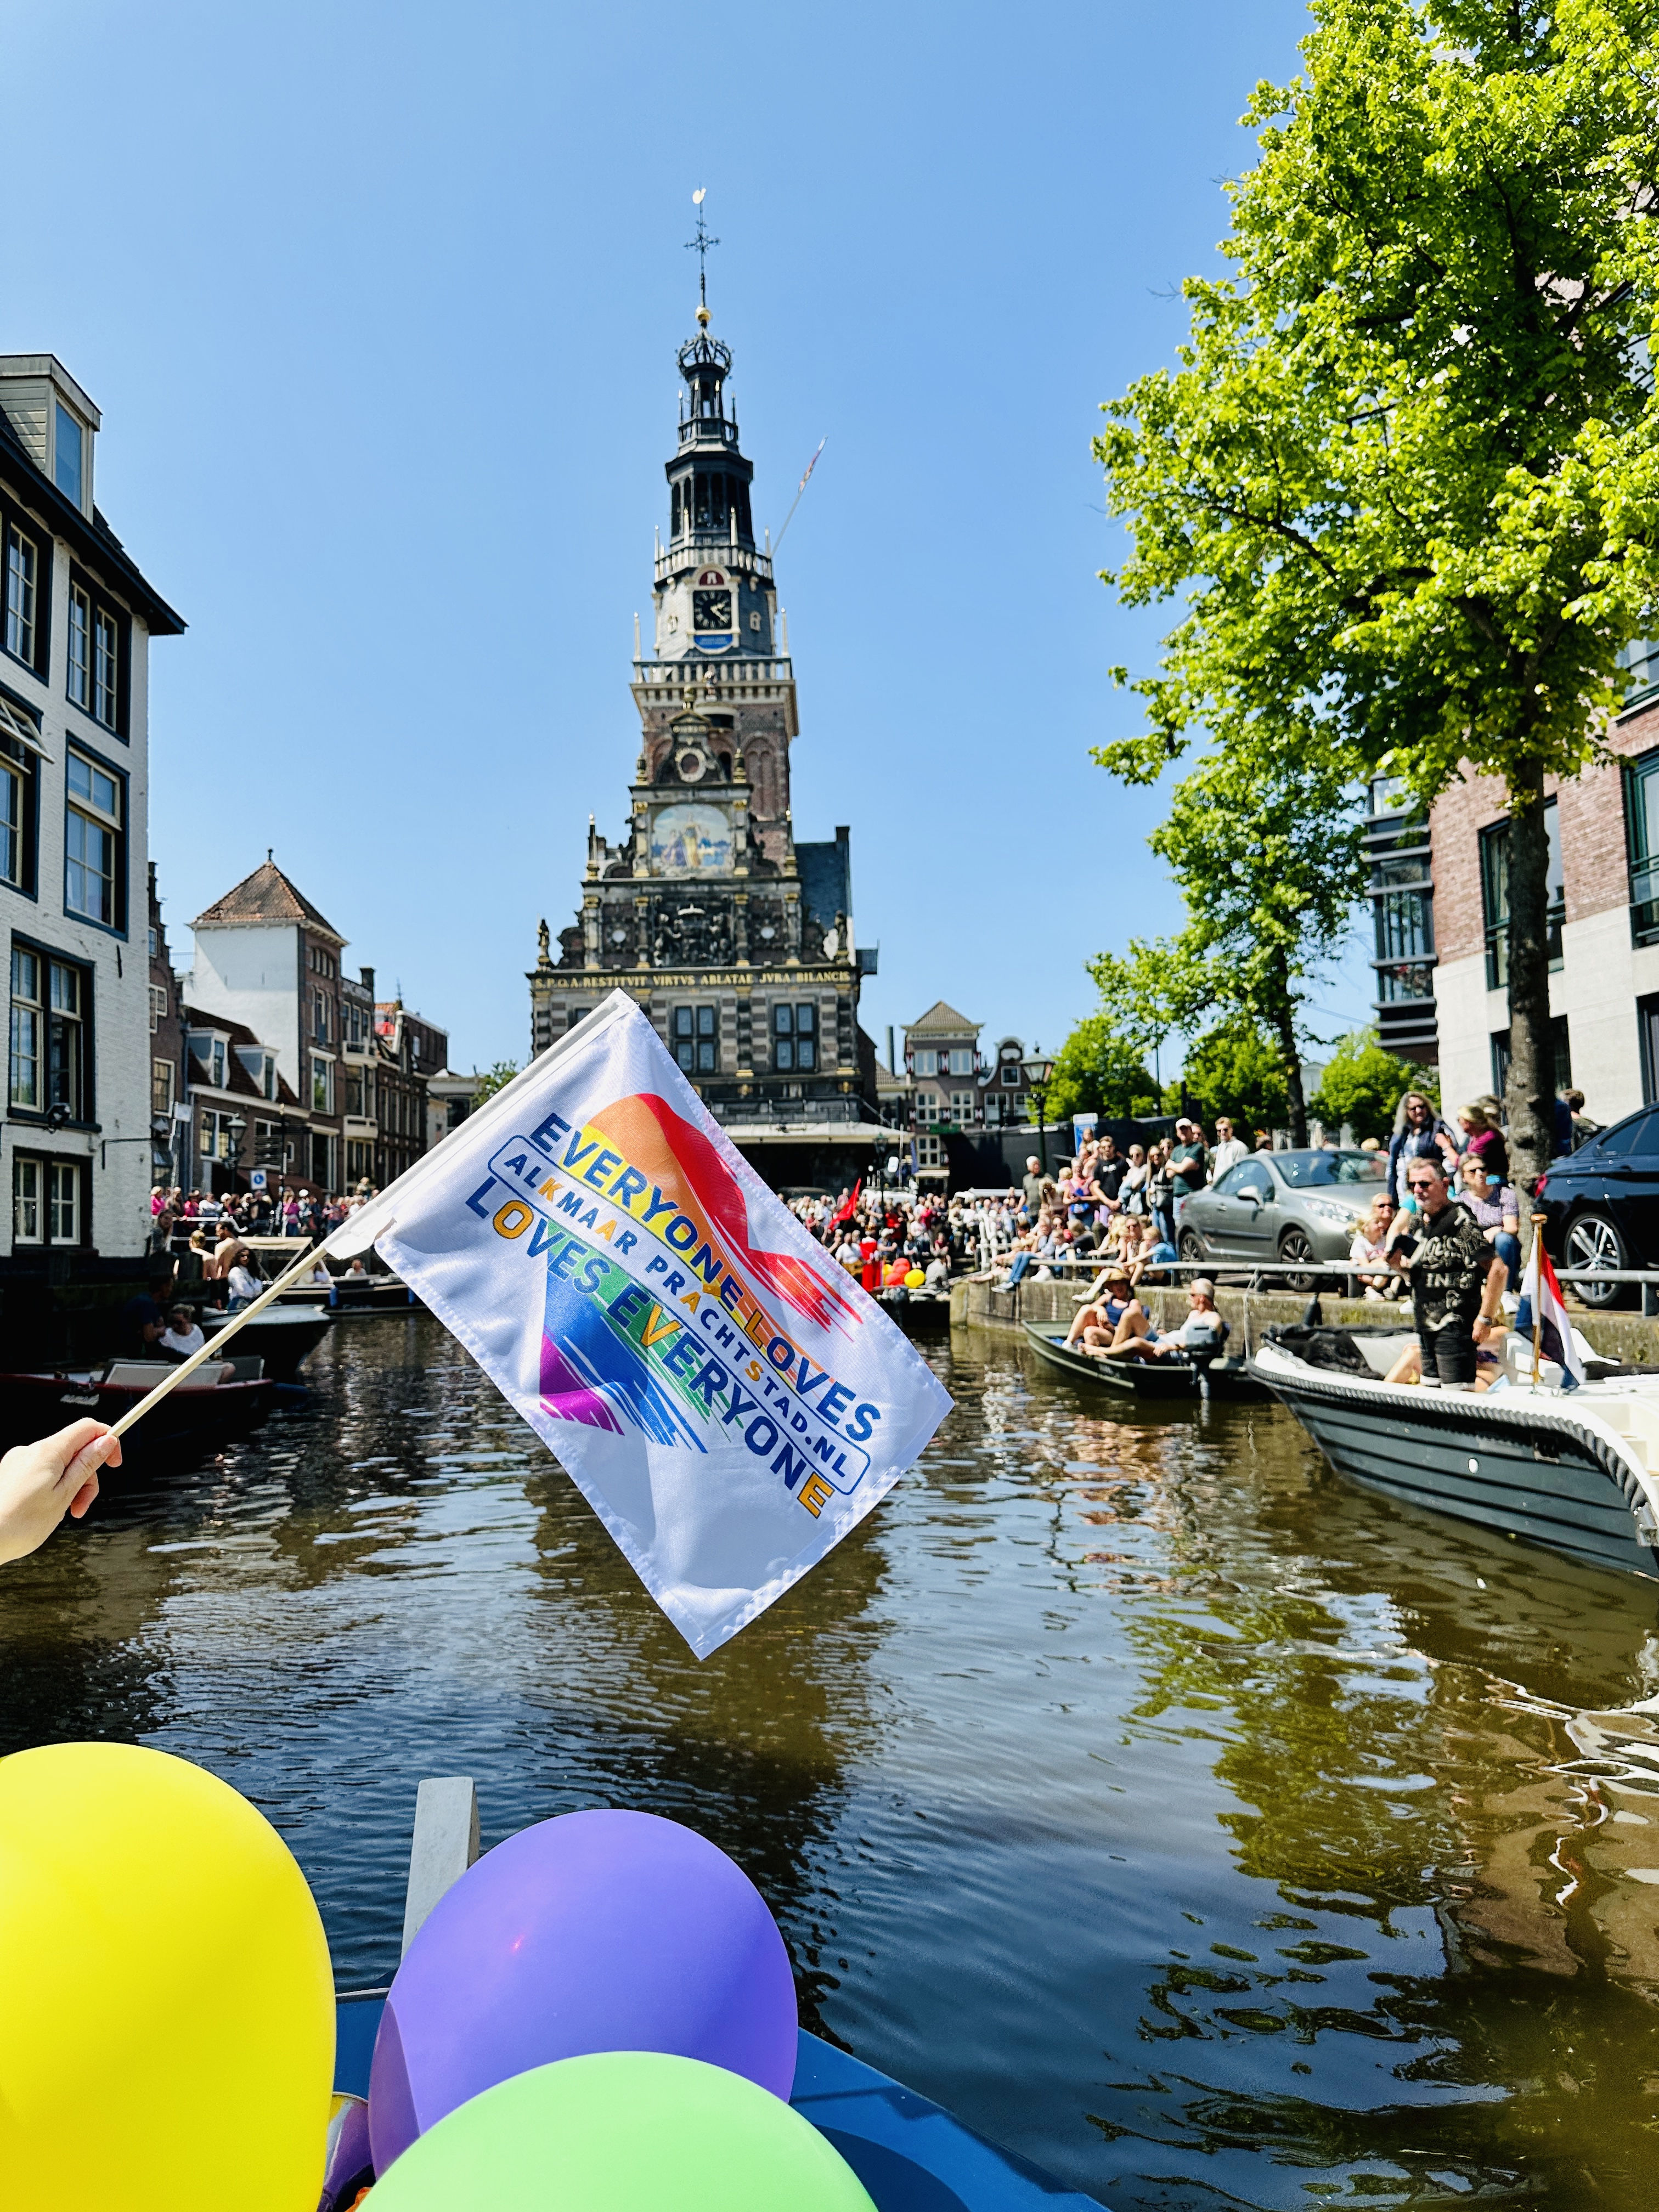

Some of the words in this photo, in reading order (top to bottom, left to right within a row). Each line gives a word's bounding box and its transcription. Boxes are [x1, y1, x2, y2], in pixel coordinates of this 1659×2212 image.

[583, 975, 648, 988] RESTITVIT
[653, 974, 696, 986] VIRTVS
[700, 973, 754, 985] ABLATAE
[759, 972, 791, 984] JVRA
[796, 971, 851, 983] BILANCIS
[465, 1176, 611, 1294] LOVES
[606, 1282, 836, 1519] EVERYONE
[504, 1153, 638, 1256] ALKMAAR
[645, 1255, 848, 1478] PRACHTSTAD.NL
[529, 1112, 744, 1312] EVERYONE
[744, 1309, 881, 1442] LOVES
